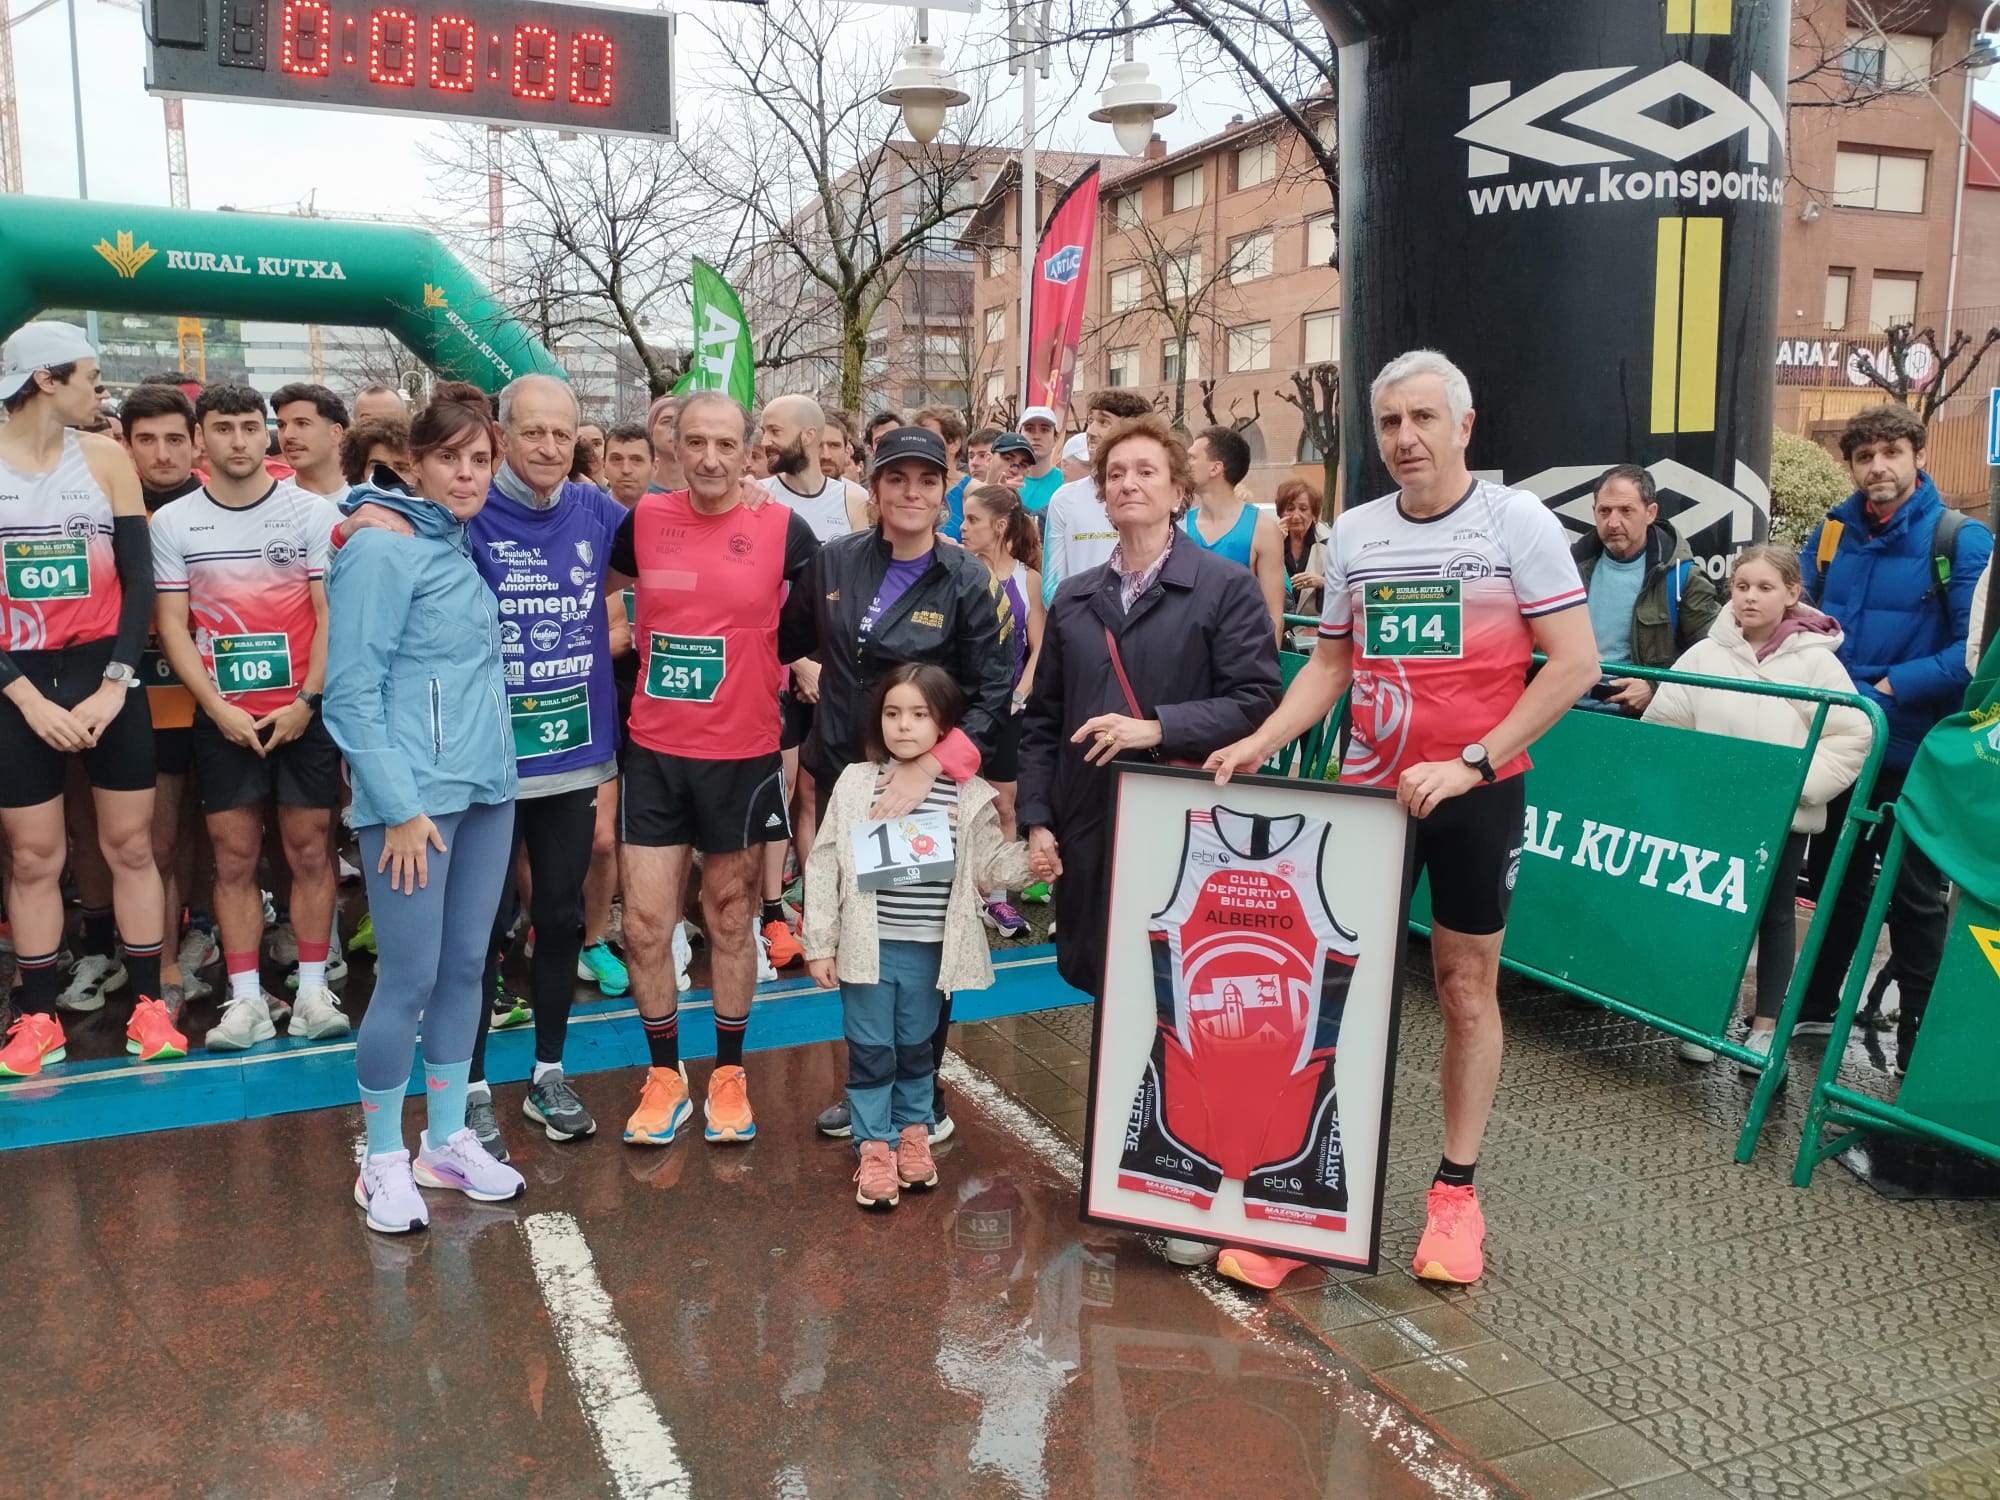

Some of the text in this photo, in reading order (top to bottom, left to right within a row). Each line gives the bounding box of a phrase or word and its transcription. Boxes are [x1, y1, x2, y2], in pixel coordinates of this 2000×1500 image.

[167, 250, 346, 280] RURAL KUTXA
[445, 310, 514, 380] RURAL KUTXA
[20, 565, 76, 589] 601
[498, 581, 559, 591] Amorrortu
[505, 573, 548, 582] Alberto
[1380, 614, 1445, 642] 514
[229, 660, 272, 682] 108
[661, 665, 702, 690] 251
[539, 719, 569, 743] 32
[868, 823, 901, 870] 1
[1192, 849, 1215, 863] ebi
[1571, 819, 1748, 914] KUTXA
[1230, 874, 1268, 886] CLUB
[1206, 883, 1291, 899] DEPORTIVO
[1221, 896, 1277, 910] BILBAO
[1205, 910, 1294, 930] ALBERTO
[1155, 1154, 1179, 1169] ebi
[1263, 1175, 1287, 1189] ebi
